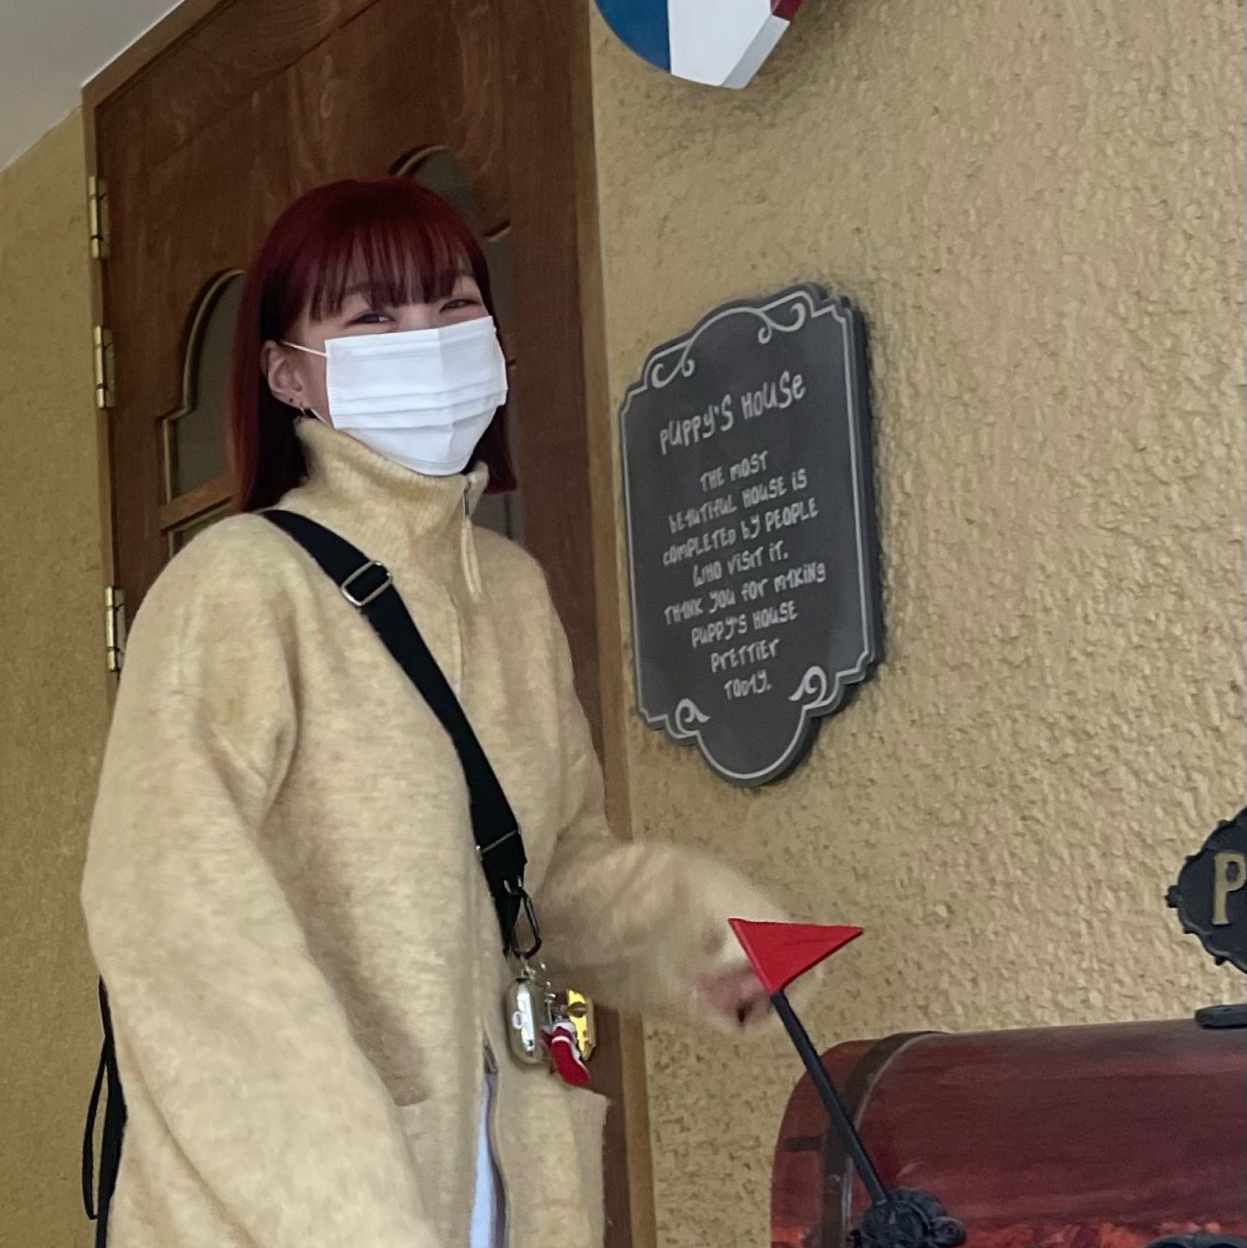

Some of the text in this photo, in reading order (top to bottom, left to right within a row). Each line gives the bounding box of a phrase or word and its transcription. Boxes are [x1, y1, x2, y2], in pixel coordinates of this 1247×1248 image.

[700, 450, 768, 492] THE MOST
[741, 476, 788, 508] HOUSE
[662, 527, 737, 567] COMPLETED
[764, 497, 819, 532] PEOPLE
[692, 560, 723, 588] WHO
[726, 546, 764, 576] VISIT
[663, 597, 704, 625] THANK
[708, 588, 737, 614] YOU
[773, 561, 826, 593] MAKING
[691, 600, 799, 648] PUPPY'S HOUSE
